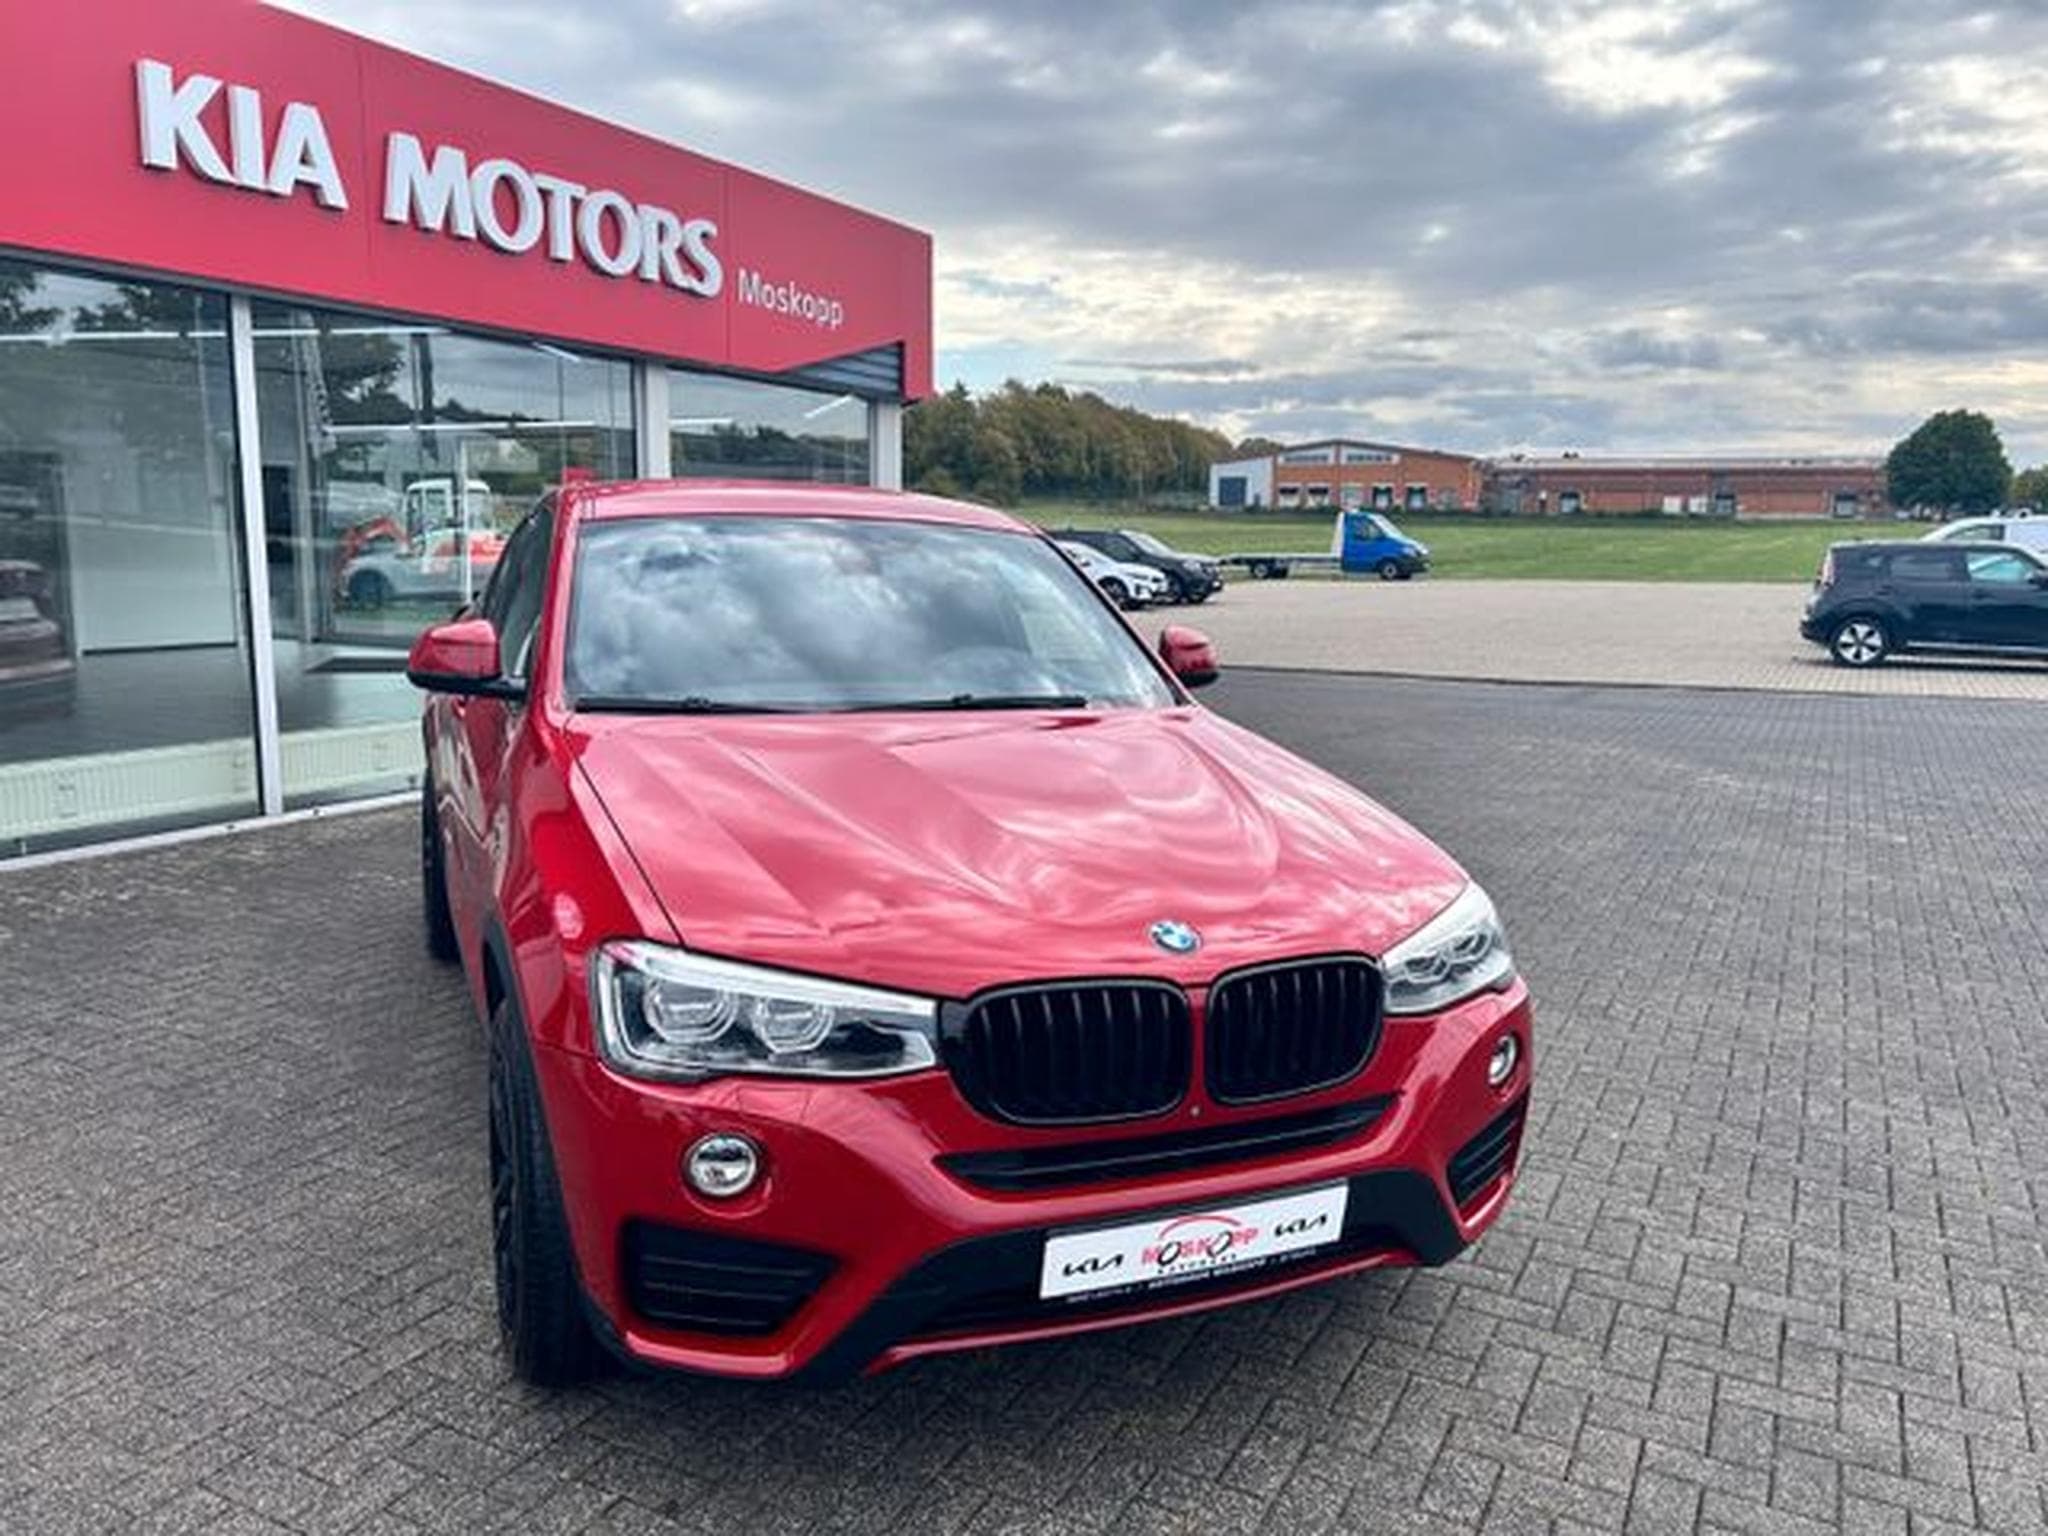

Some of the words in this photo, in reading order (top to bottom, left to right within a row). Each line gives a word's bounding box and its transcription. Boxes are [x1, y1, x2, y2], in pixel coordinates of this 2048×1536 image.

[136, 58, 349, 211] KIA
[383, 132, 723, 298] MOTORS
[739, 267, 843, 330] Moskopp
